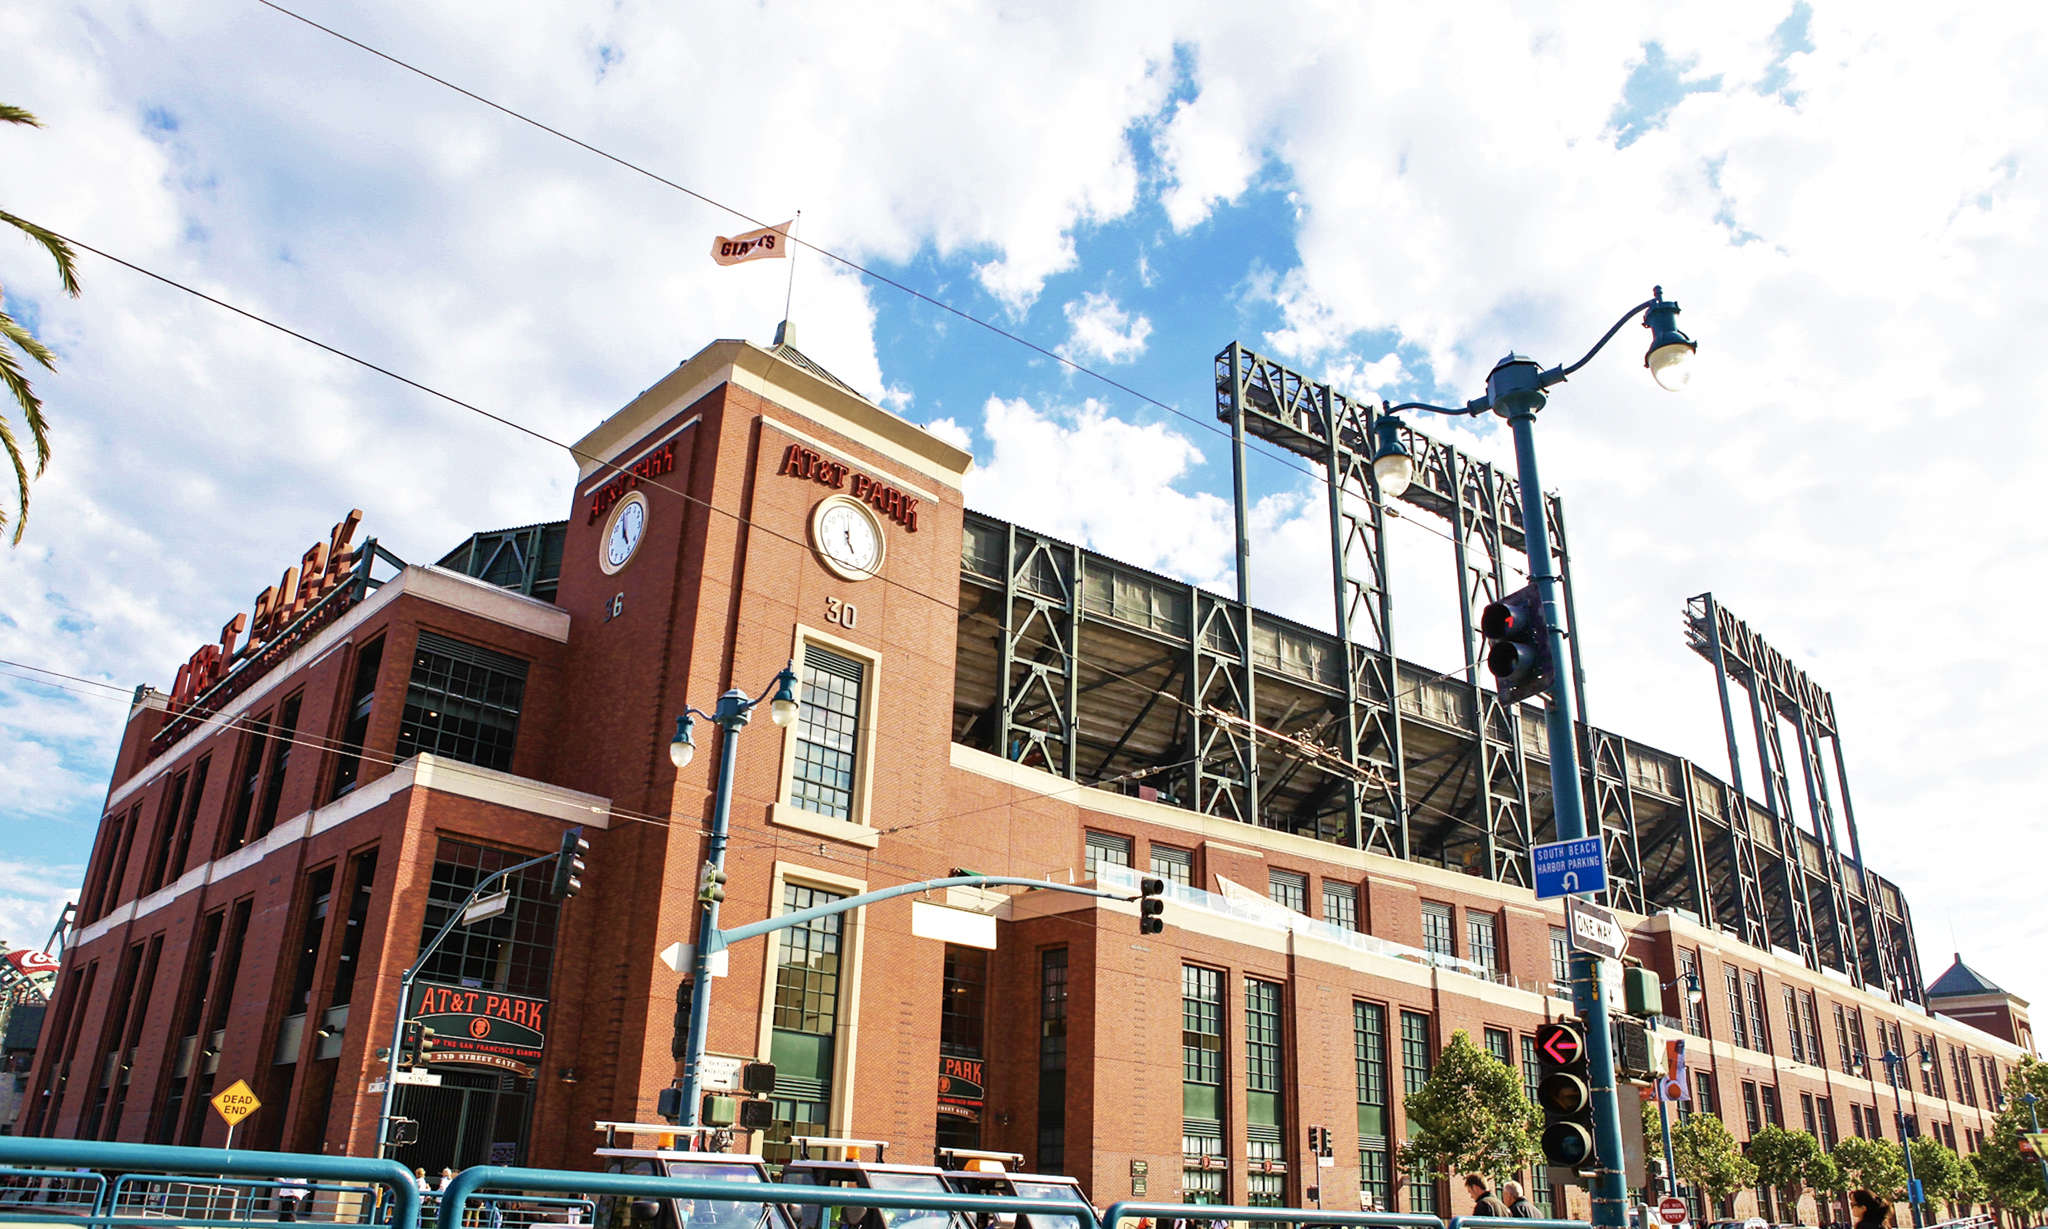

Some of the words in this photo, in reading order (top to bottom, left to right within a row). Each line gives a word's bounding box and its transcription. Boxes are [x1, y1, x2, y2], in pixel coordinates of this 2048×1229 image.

[782, 444, 850, 489] AT&T
[853, 472, 920, 534] PARK
[824, 596, 857, 629] 30
[1536, 847, 1565, 862] SOUTH
[1568, 842, 1598, 857] BEACH
[1536, 860, 1566, 875] HARBOR
[1567, 855, 1601, 870] PARKING
[1577, 914, 1594, 937] ONE
[1597, 924, 1612, 943] WAY
[418, 987, 480, 1016] AT&T
[484, 995, 544, 1032] PARK
[443, 1040, 457, 1048] THE
[459, 1040, 474, 1049] SAN
[476, 1042, 514, 1055] FRANCISCO
[516, 1049, 542, 1058] GIANTS
[459, 1054, 493, 1063] STREET
[495, 1058, 516, 1068] GATE
[945, 1059, 982, 1085] PARK
[223, 1094, 253, 1105] DEAD
[224, 1105, 247, 1115] END
